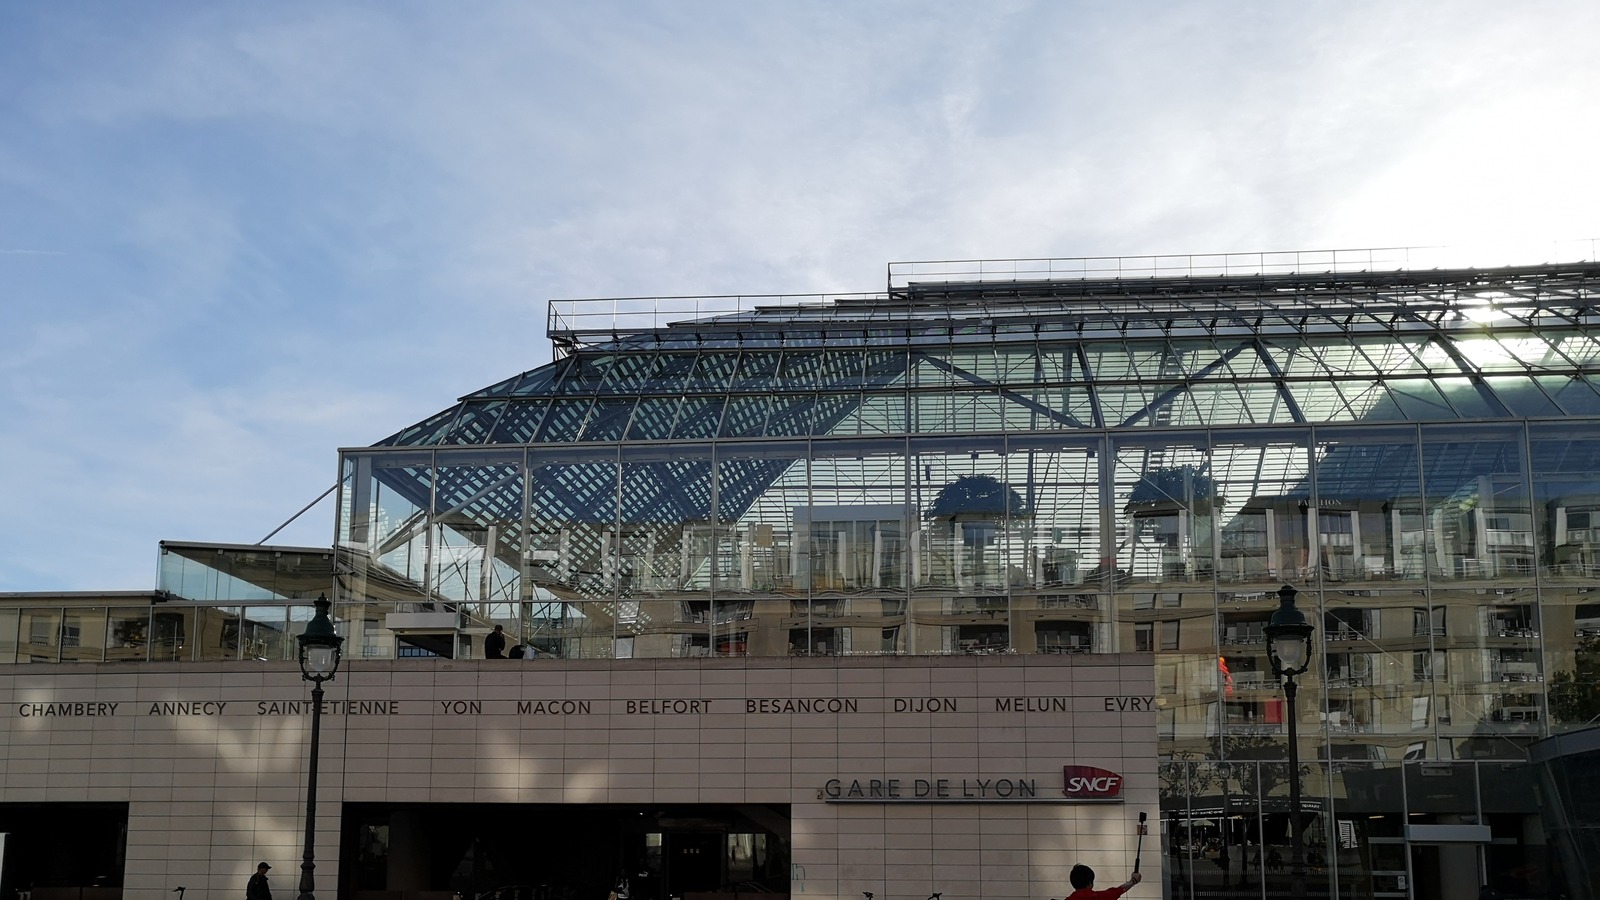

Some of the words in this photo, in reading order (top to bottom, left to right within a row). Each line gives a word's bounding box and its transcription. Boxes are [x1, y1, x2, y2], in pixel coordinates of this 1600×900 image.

[19, 703, 119, 717] CHAMBERY
[149, 702, 227, 716] ANNECY
[441, 701, 482, 715] YON
[517, 701, 591, 715] MACON
[626, 700, 712, 714] BELFORT
[746, 699, 858, 713] BESANCON
[894, 698, 957, 712] DIJON
[996, 698, 1066, 711] MELUN
[1104, 697, 1154, 711] EVRY
[825, 779, 900, 797] GARE
[914, 779, 949, 797] DE
[963, 779, 1036, 797] LYON
[1067, 777, 1119, 792] SNCF
